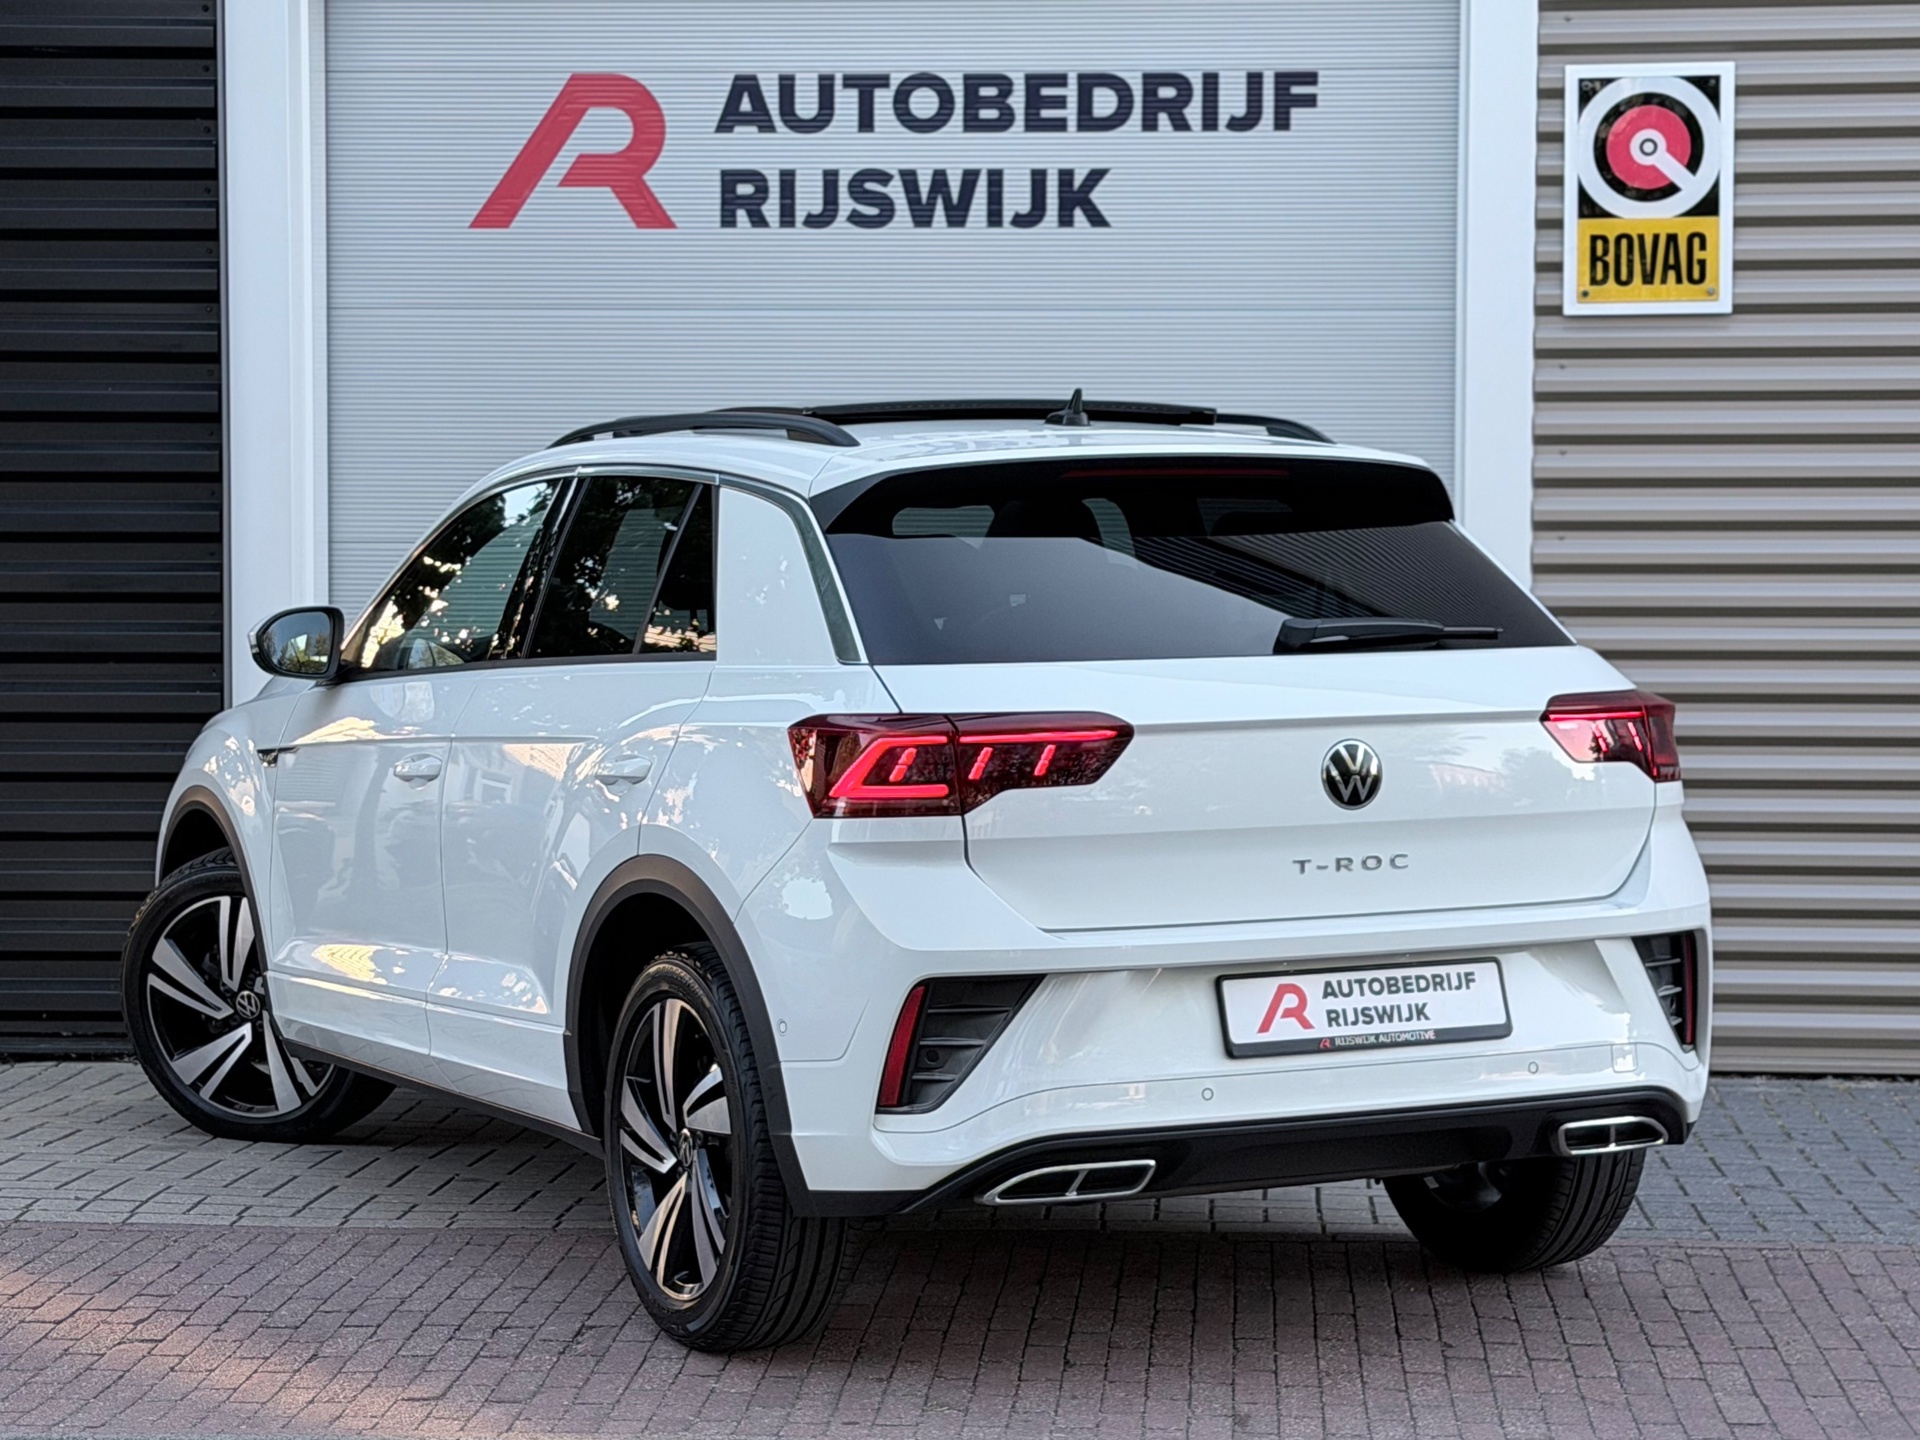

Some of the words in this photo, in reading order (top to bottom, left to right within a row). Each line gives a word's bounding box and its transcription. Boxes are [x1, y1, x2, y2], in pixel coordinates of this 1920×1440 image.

[715, 71, 1318, 133] AUTOBEDRIJF
[720, 168, 1111, 229] RIJSWIJK
[1589, 231, 1708, 286] BOVAG
[1292, 853, 1409, 875] T-ROC
[1321, 971, 1477, 999] AUTOBEDRIJF
[1326, 1002, 1431, 1028] RIJSWIJK
[1334, 1034, 1377, 1047] RIJSWIJK
[1378, 1030, 1436, 1043] AUTOMOTIVE
